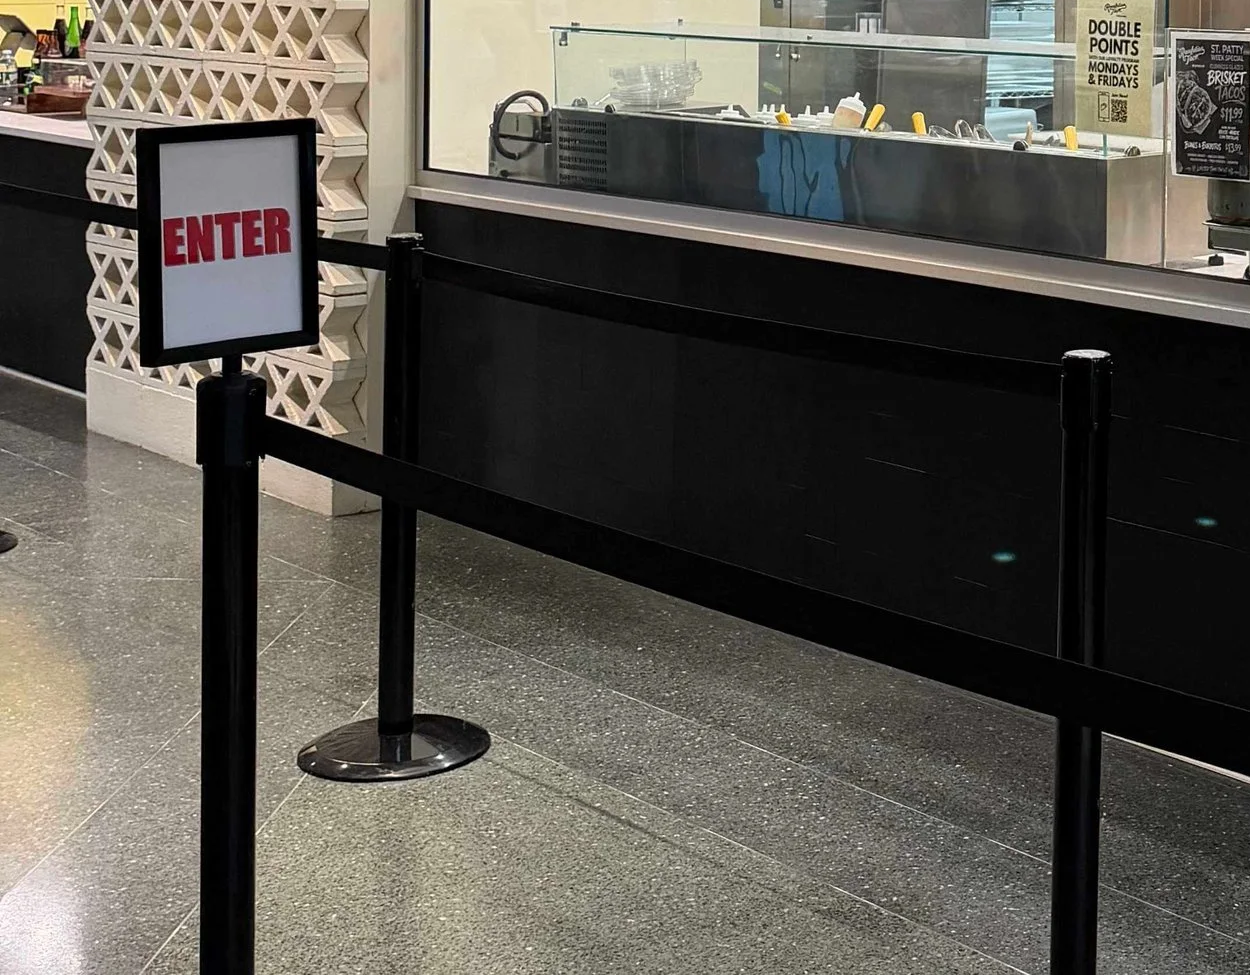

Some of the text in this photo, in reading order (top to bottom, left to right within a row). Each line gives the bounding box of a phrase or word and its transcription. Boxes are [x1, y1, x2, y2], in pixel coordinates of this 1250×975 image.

[1089, 19, 1141, 38] DOUBLE
[1090, 37, 1139, 56] POINTS
[1211, 44, 1244, 54] ST. PATTY
[1088, 61, 1139, 76] MONDAYS
[1088, 73, 1139, 89] & FRIDAYS
[1207, 70, 1247, 86] BRISKET
[1215, 86, 1246, 101] TACOS
[163, 208, 291, 267] ENTER
